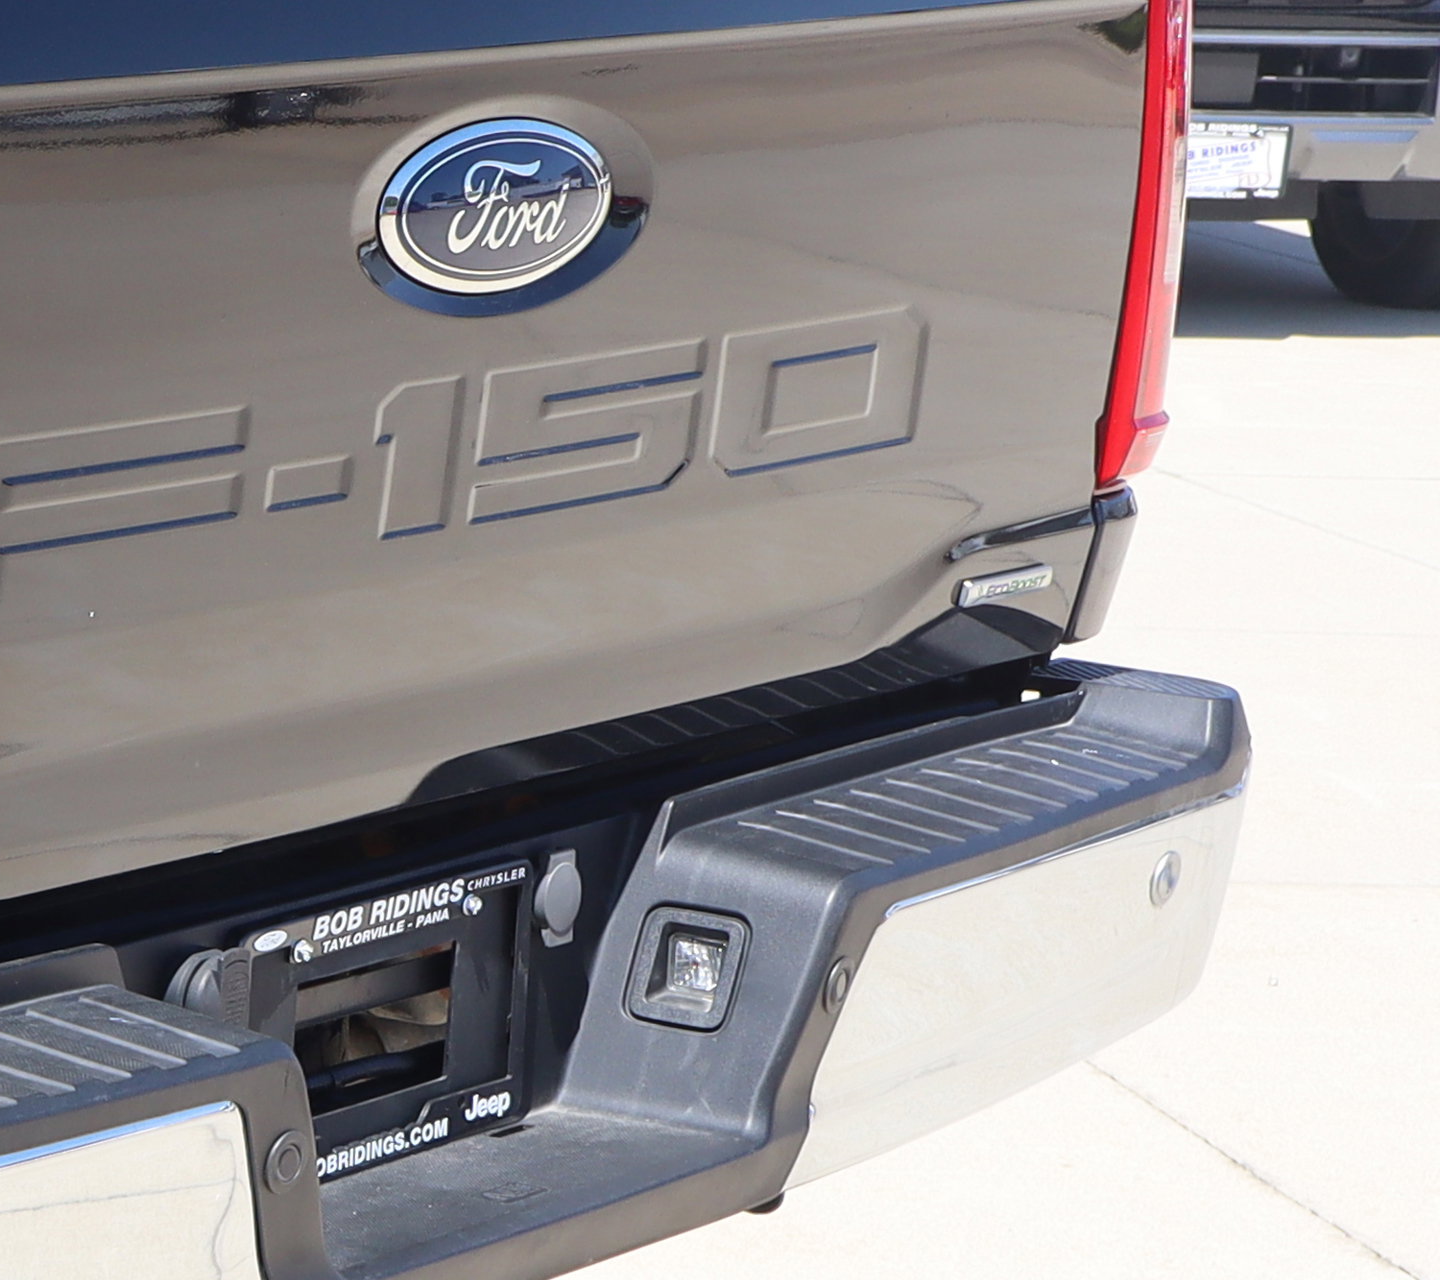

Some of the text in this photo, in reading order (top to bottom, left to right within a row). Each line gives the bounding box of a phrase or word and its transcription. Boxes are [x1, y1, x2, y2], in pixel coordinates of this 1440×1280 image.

[1202, 141, 1257, 158] RIDINGS
[447, 160, 569, 254] Ford
[467, 867, 526, 891] CHRYSLER
[312, 905, 364, 941] BOB
[369, 878, 466, 925] RIDINGS
[321, 919, 405, 954] TAYLORVILLE
[416, 908, 450, 928] PANA
[464, 1090, 511, 1121] Jeep
[316, 1117, 449, 1178] OBRIDINGS.COM
